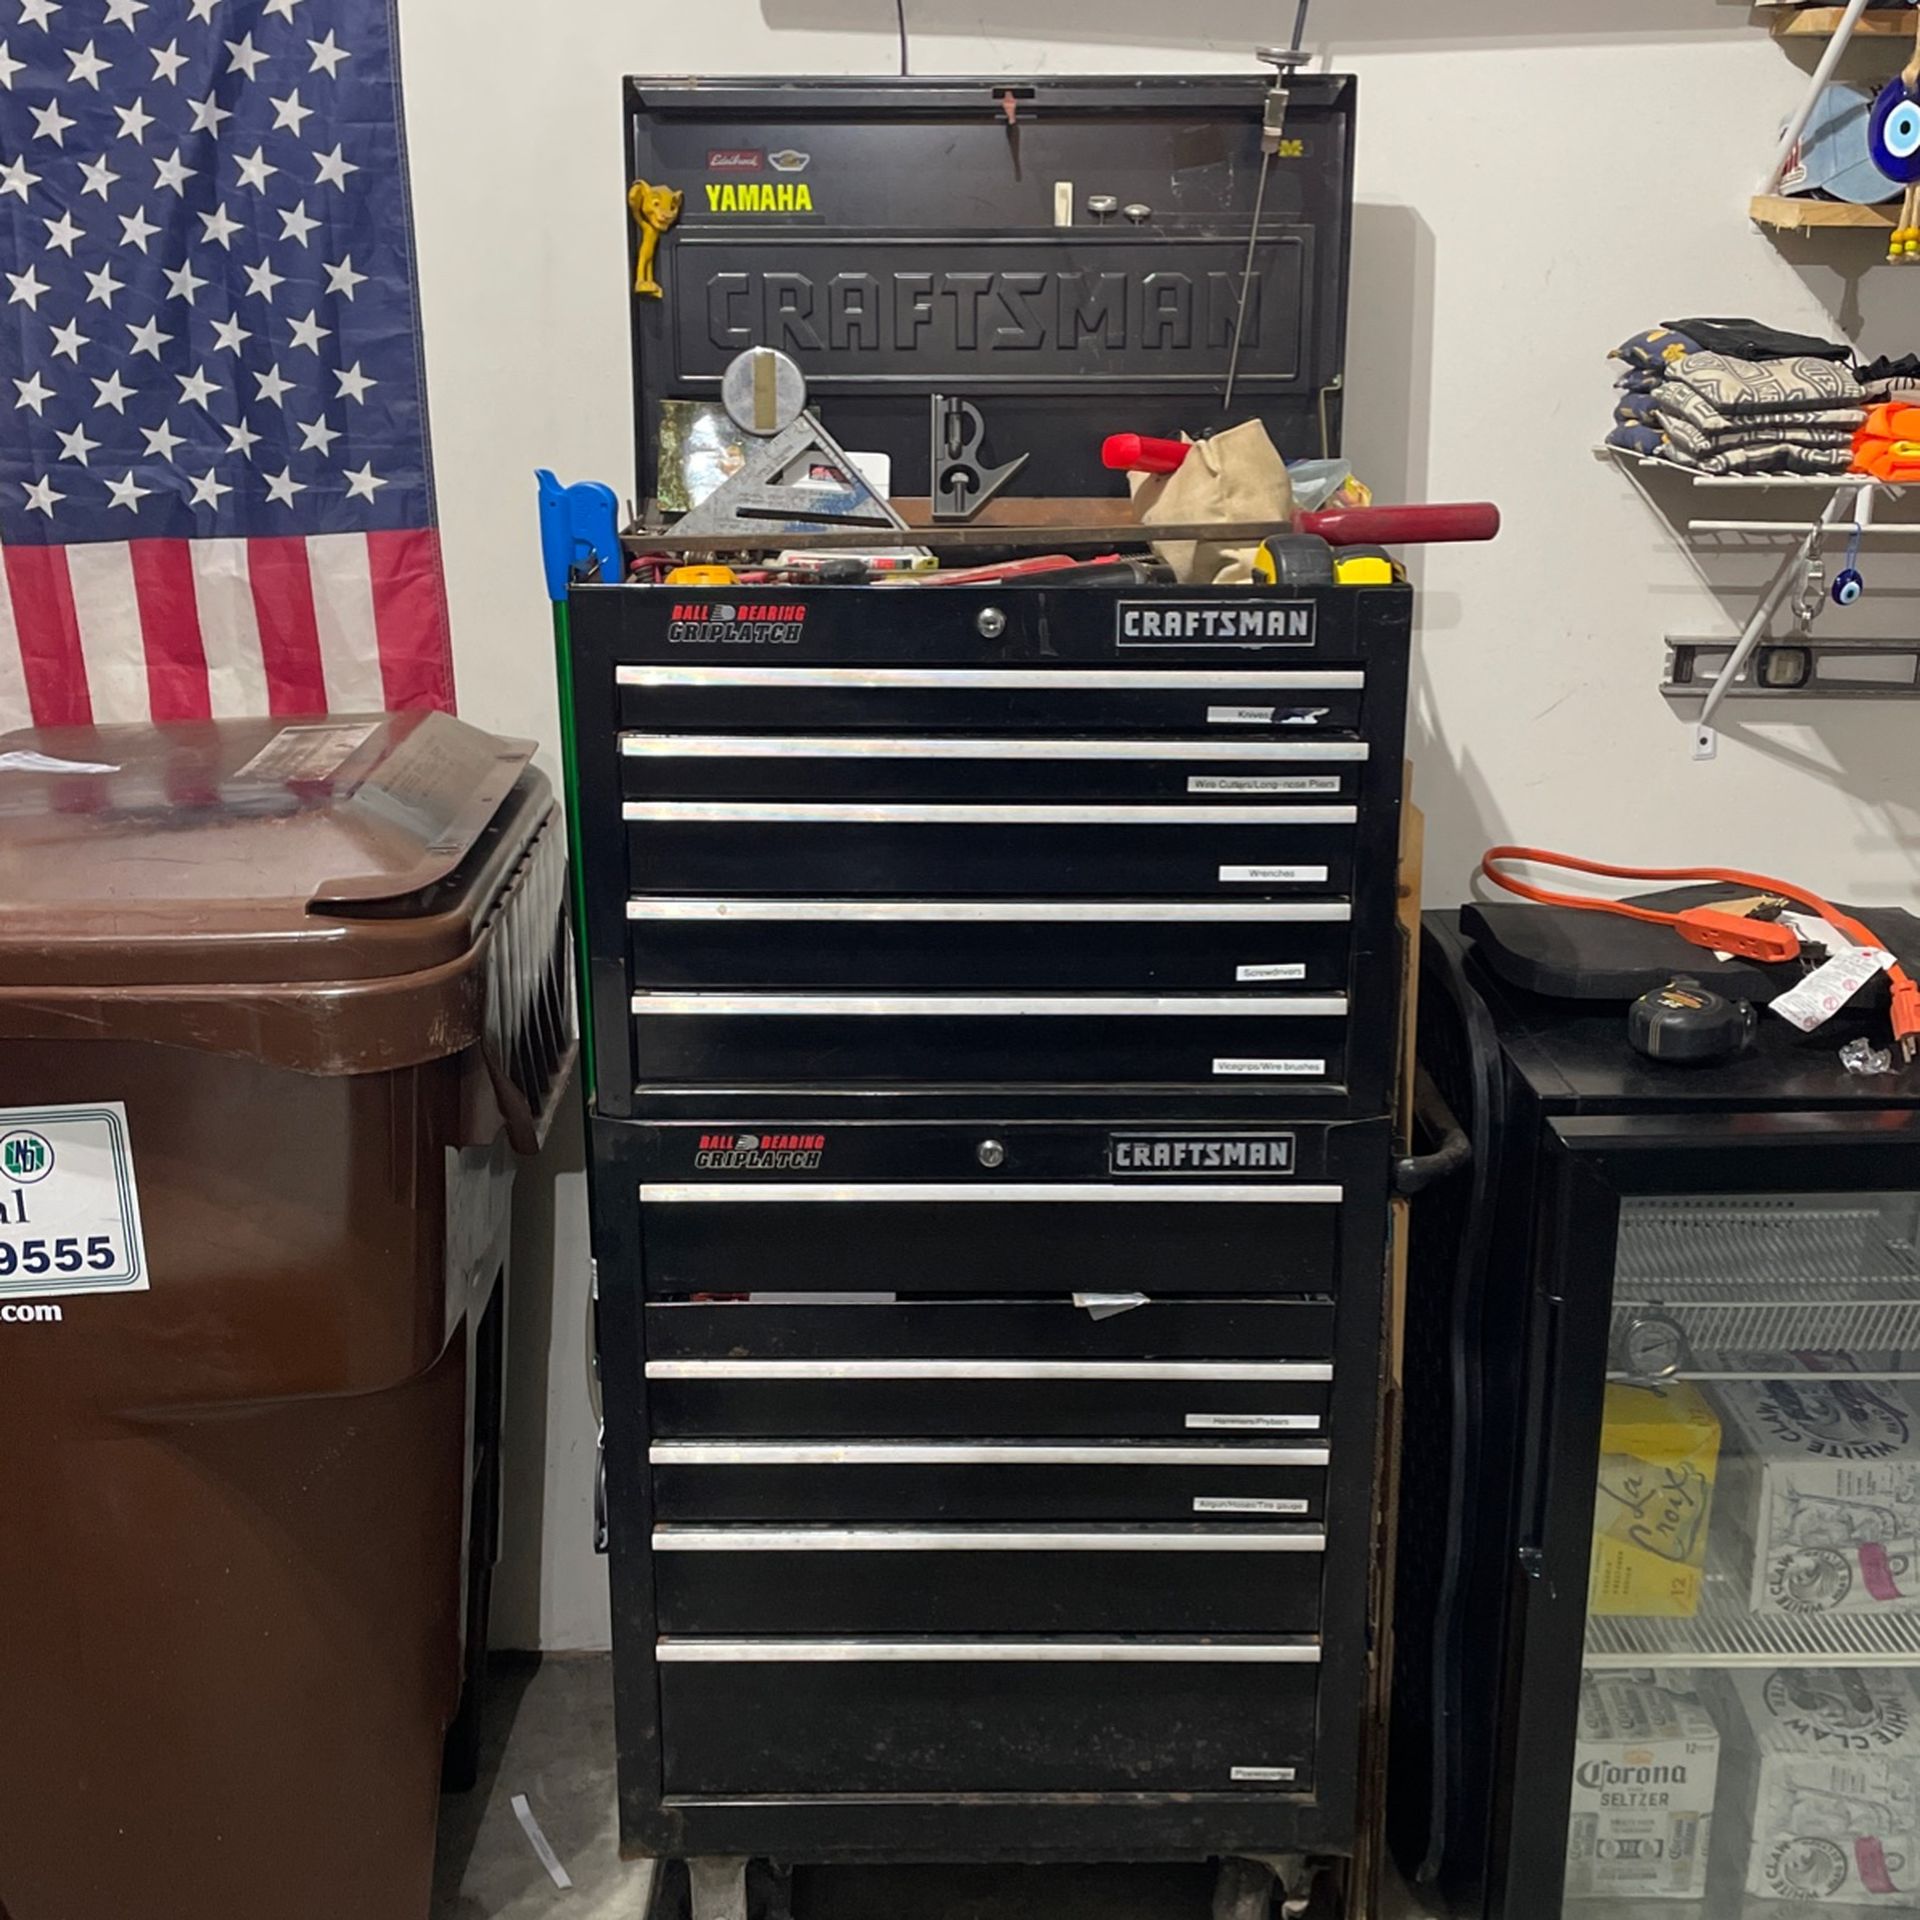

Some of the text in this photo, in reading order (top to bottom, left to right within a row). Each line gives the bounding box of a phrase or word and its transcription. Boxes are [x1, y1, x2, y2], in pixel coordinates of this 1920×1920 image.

[705, 183, 813, 212] YAMAHA
[707, 271, 1262, 351] CRAFTSMAN
[671, 604, 807, 621] BALL BEARING
[668, 621, 804, 644] GRIPLATCH
[1124, 610, 1309, 637] CRAFTSMAN
[1195, 779, 1217, 789] Wire
[1248, 869, 1295, 878] Wrenches
[1243, 967, 1302, 977] Screwdrivers
[698, 1134, 825, 1150] BALL BEARING
[694, 1150, 823, 1169] GRIPLATCH
[1116, 1141, 1288, 1166] CRAFTSMAN
[1806, 1440, 1899, 1460] WHITE
[1769, 1553, 1795, 1596] CLAW
[1783, 1718, 1869, 1750] CLAW
[1685, 1742, 1698, 1755] 12
[1576, 1759, 1687, 1793] Corona
[1600, 1792, 1670, 1808] SELTZER
[1765, 1841, 1792, 1880] CLAW
